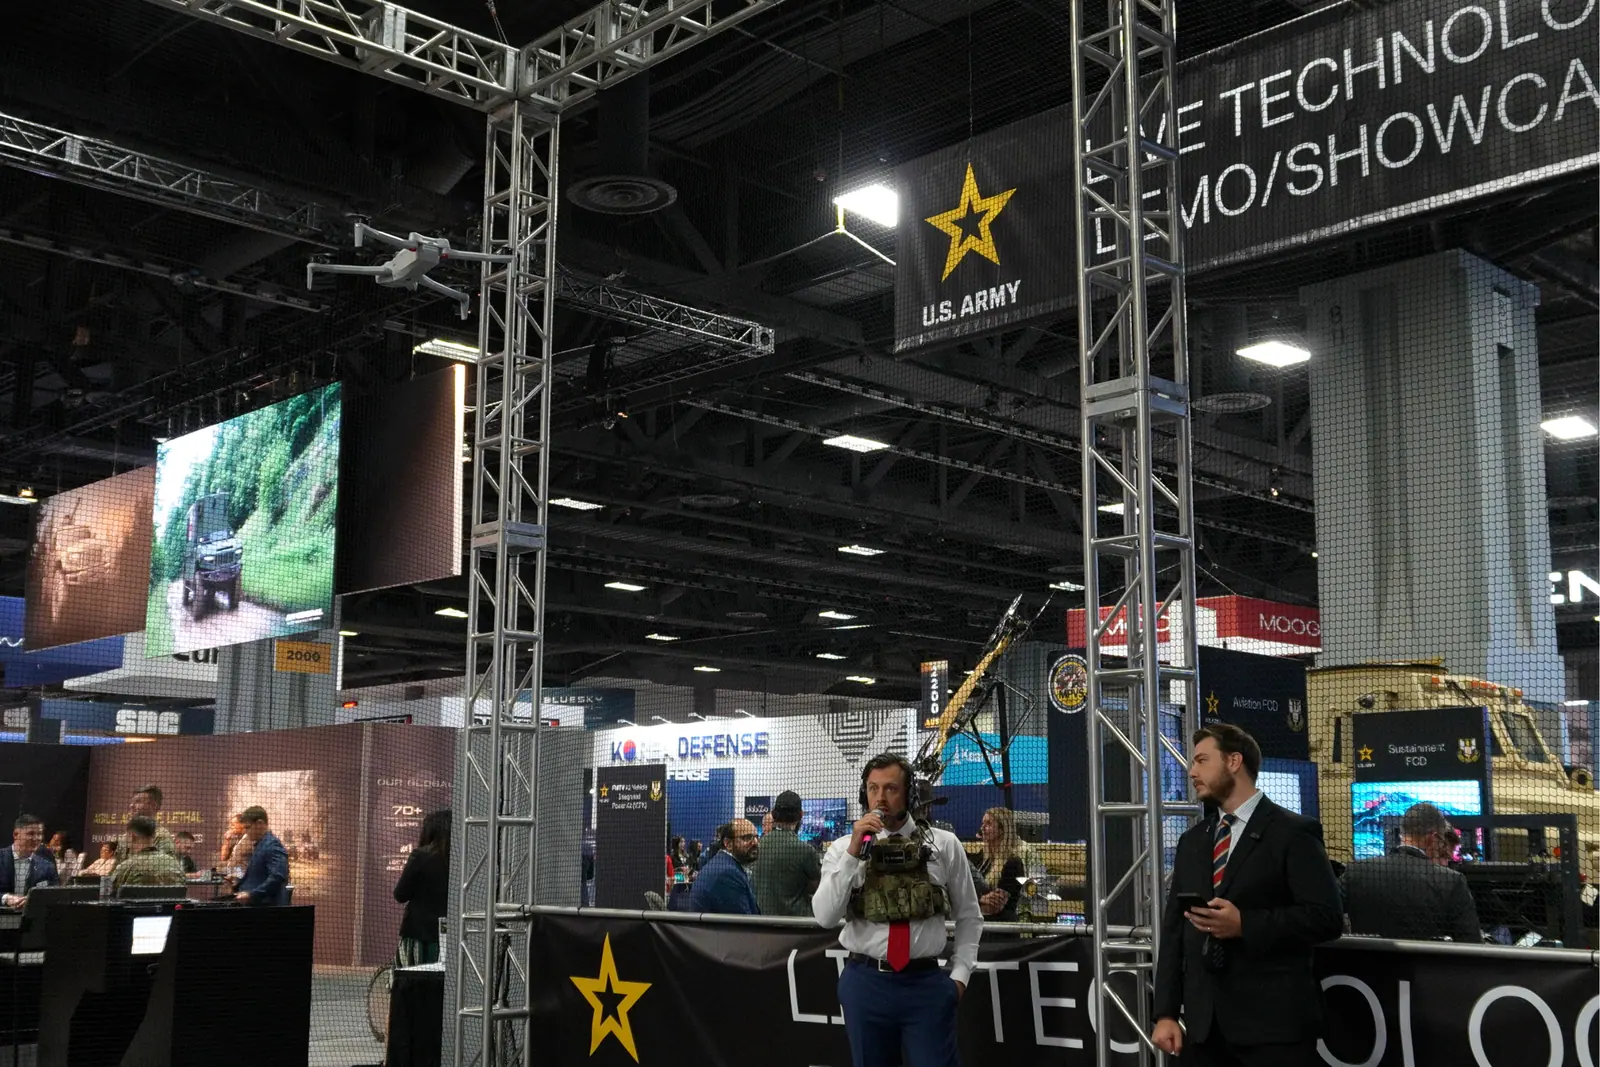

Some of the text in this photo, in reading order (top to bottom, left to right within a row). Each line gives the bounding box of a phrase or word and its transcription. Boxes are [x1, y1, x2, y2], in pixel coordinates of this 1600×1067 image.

[922, 279, 1021, 327] U.S. ARMY
[1259, 612, 1321, 637] MOOG
[286, 650, 320, 662] 2000
[543, 696, 602, 704] BLUESKY
[678, 731, 769, 760] DEFENSE
[392, 805, 422, 815] 70+
